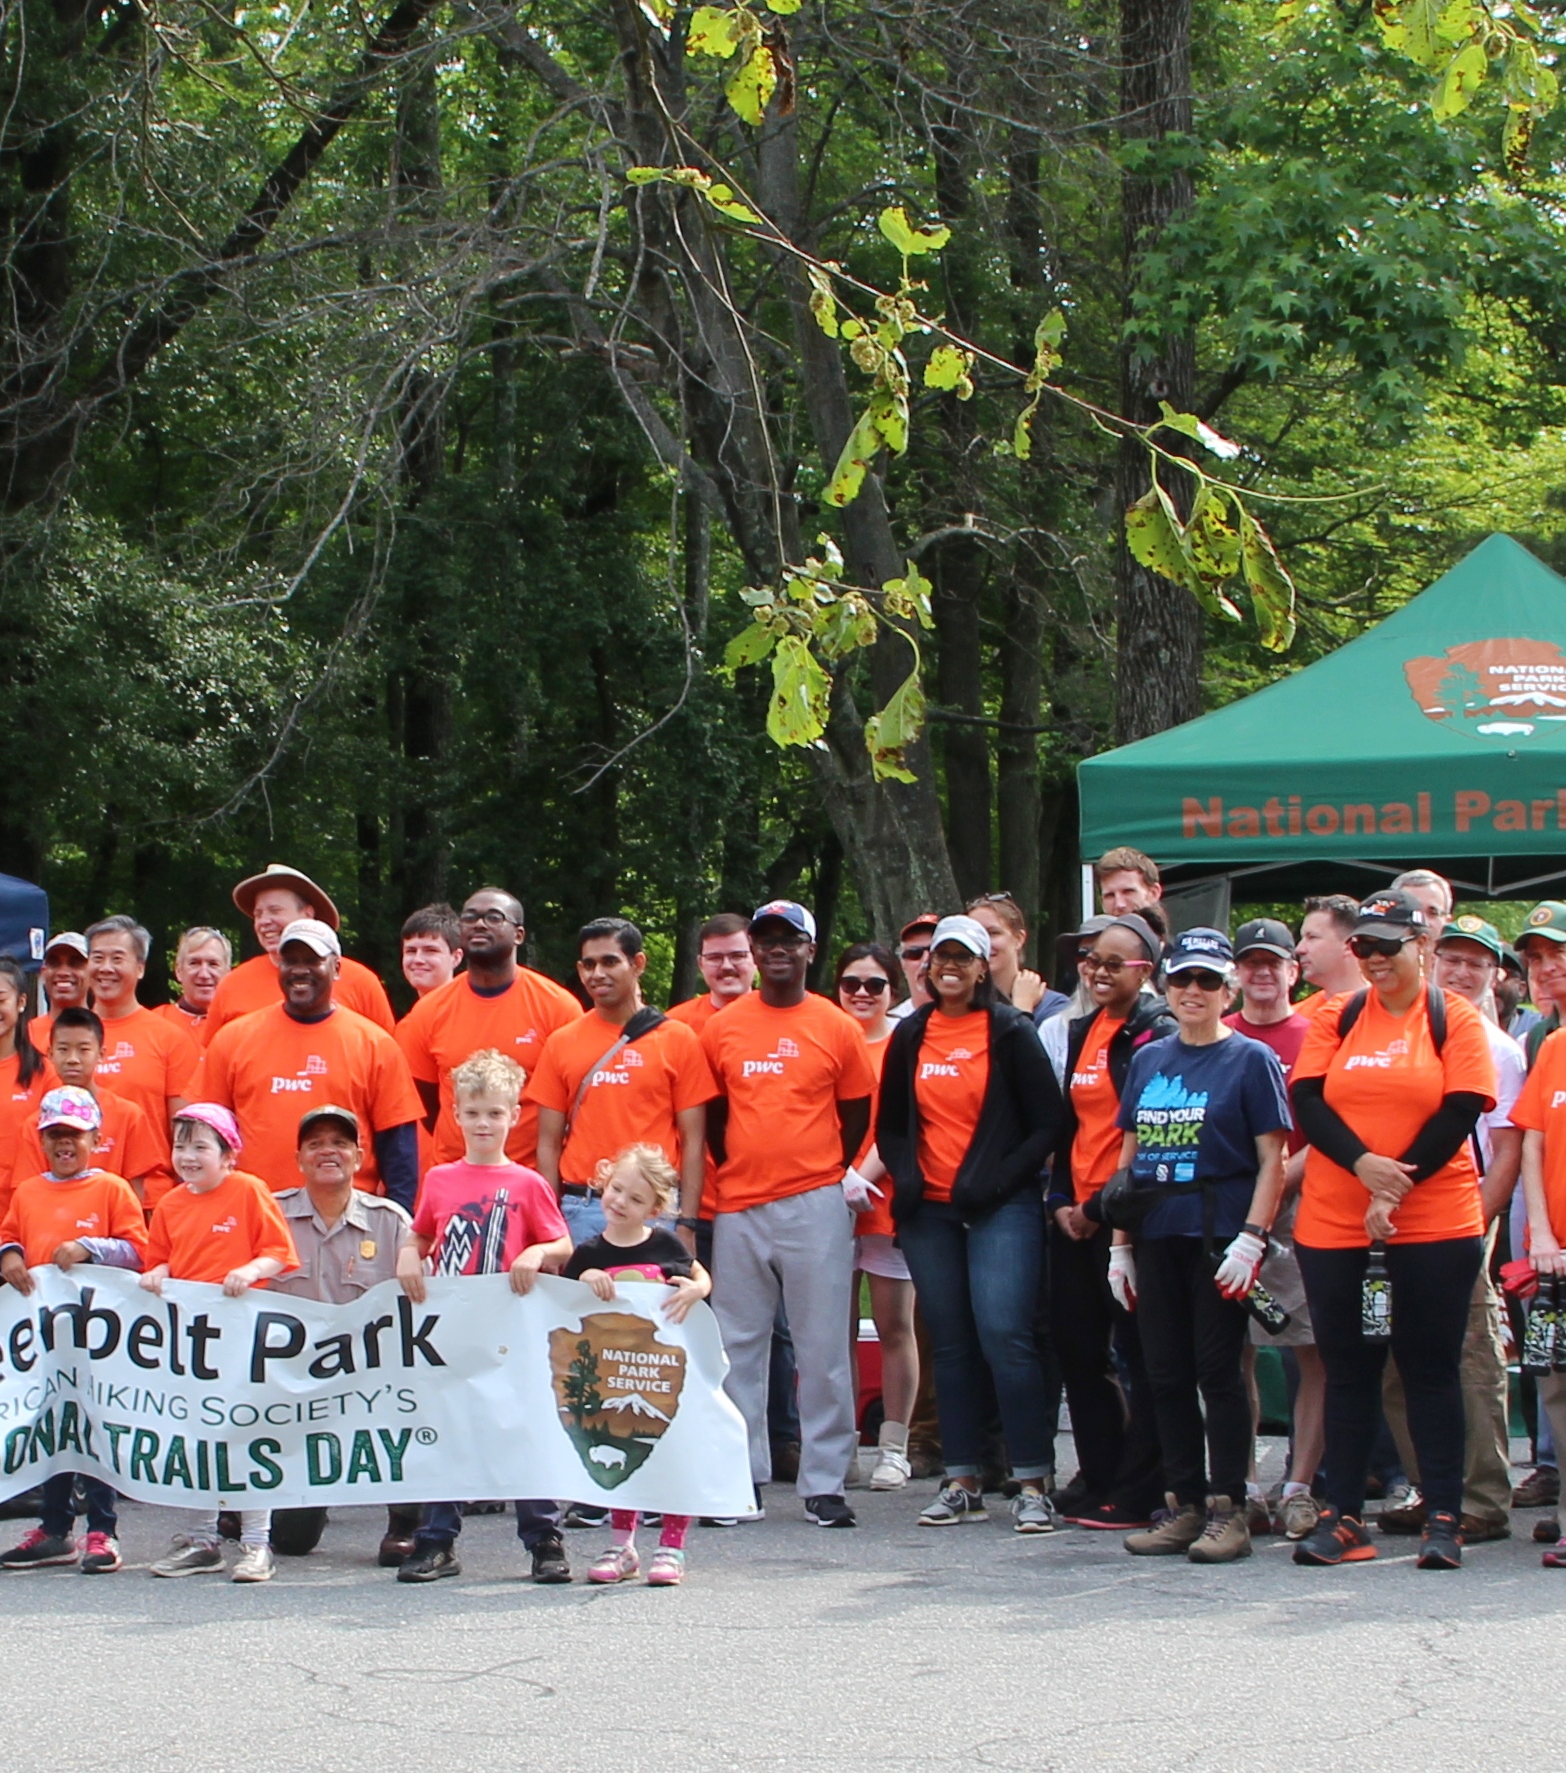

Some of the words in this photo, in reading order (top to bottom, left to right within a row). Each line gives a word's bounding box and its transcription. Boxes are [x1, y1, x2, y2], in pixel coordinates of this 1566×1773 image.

[1512, 675, 1566, 683] PARK
[1181, 792, 1431, 838] National
[95, 1061, 122, 1073] wc
[743, 1060, 784, 1077] pwc
[920, 1062, 960, 1079] pwc
[1344, 1054, 1392, 1071] pwc
[271, 1077, 312, 1093] pwc
[592, 1070, 630, 1087] pwc
[1137, 1110, 1169, 1124] FIND
[1169, 1107, 1206, 1123] YOUR
[1137, 1122, 1204, 1147] PARK
[1161, 1151, 1198, 1161] SERVICE
[212, 1224, 231, 1233] pwc
[250, 1295, 447, 1383] Park
[602, 1348, 679, 1366] NATIONAL
[618, 1364, 660, 1378] PARK
[607, 1376, 671, 1393] SERVICE
[102, 1421, 284, 1492] TRAILS
